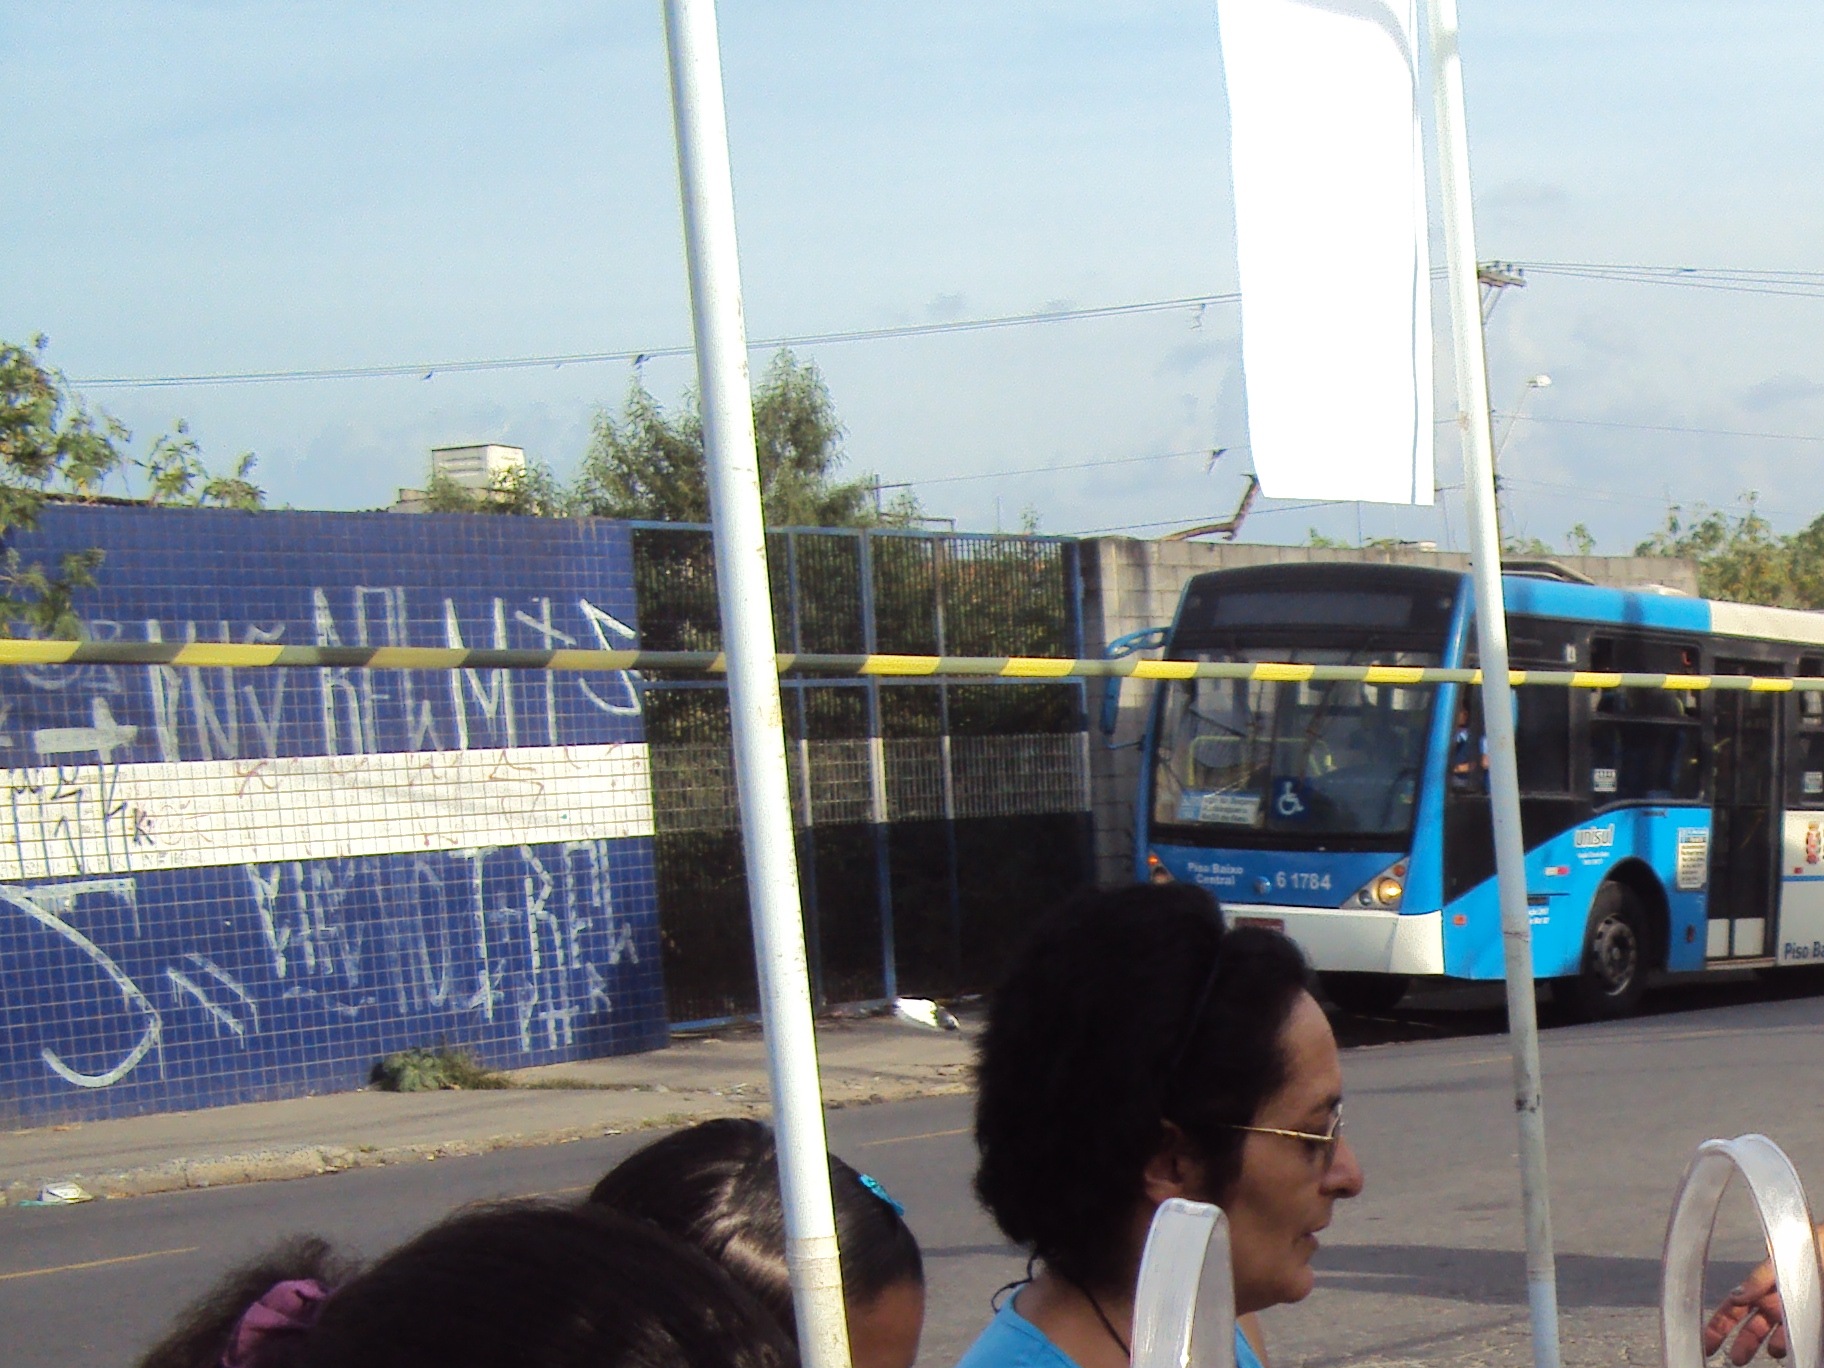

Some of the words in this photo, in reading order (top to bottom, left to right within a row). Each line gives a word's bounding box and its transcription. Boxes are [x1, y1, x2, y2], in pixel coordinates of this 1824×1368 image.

[1574, 823, 1615, 848] unisul
[1212, 863, 1243, 875] Baixo
[1196, 873, 1235, 886] Central
[1290, 873, 1331, 890] 1784
[1784, 942, 1810, 960] Piso
